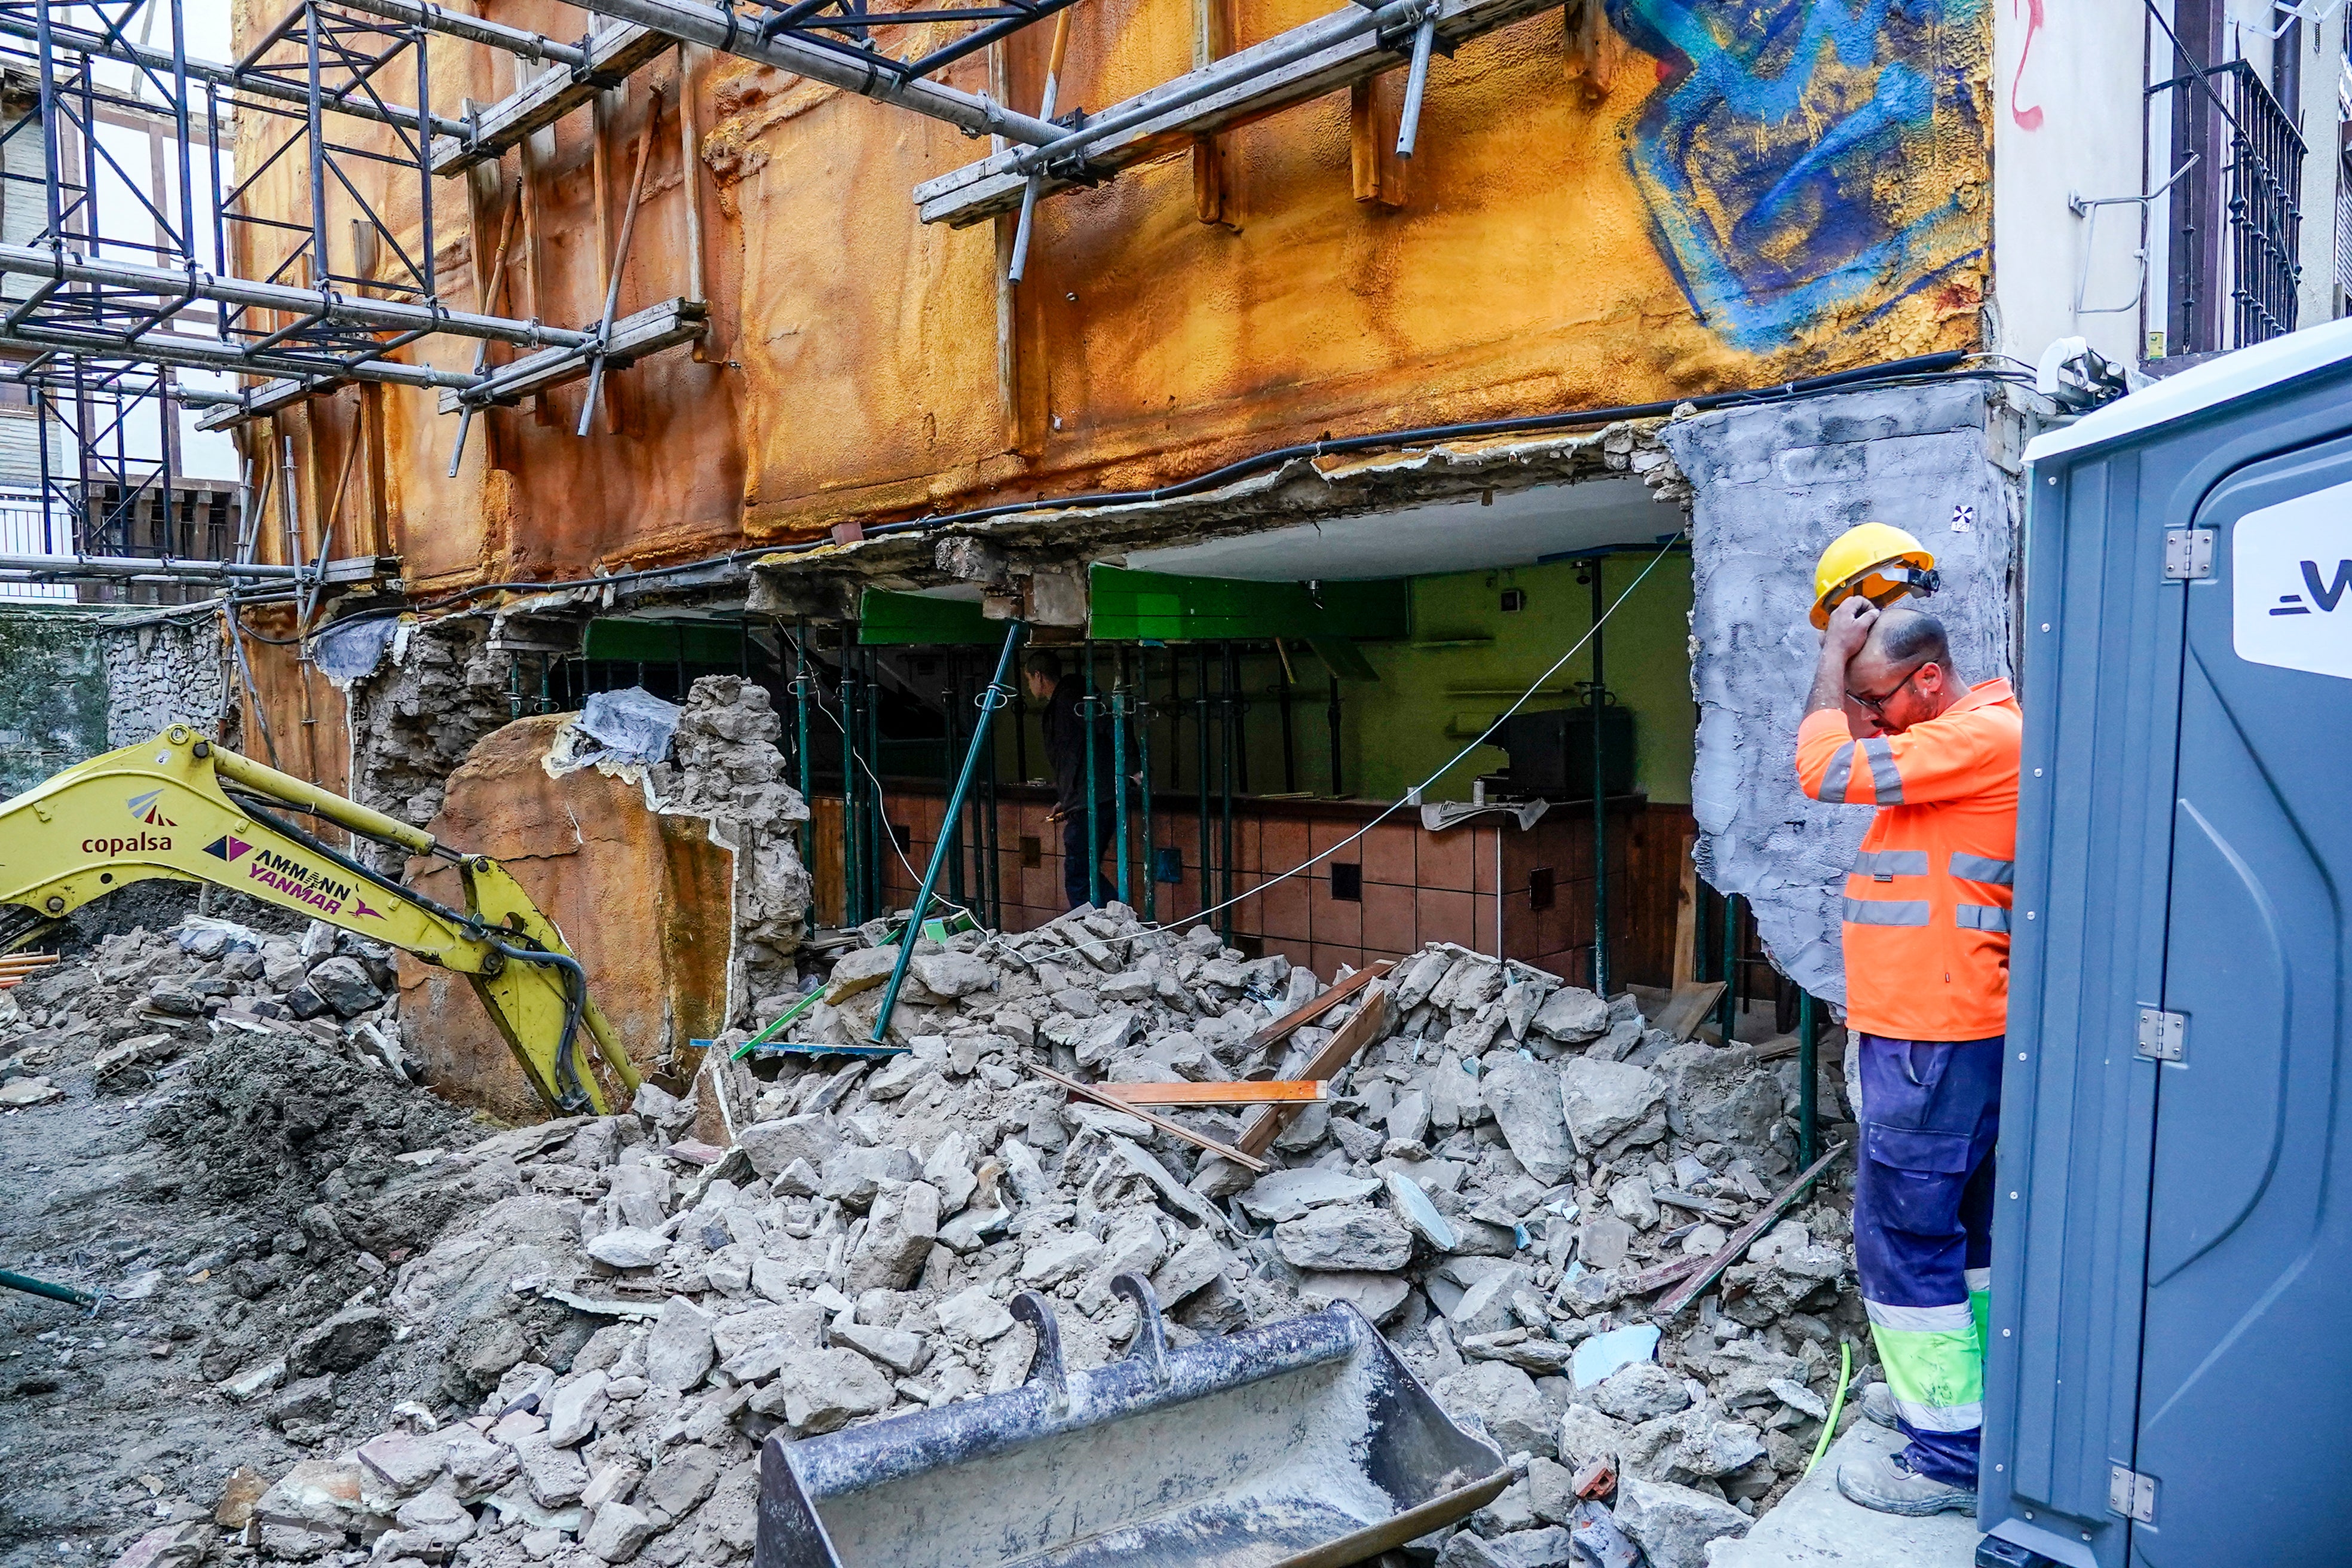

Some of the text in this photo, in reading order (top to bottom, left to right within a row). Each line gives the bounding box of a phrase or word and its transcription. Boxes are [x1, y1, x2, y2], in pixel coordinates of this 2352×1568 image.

[82, 831, 172, 858] copalsa
[249, 862, 342, 915] YANMAR
[255, 849, 351, 901] AMMANN
